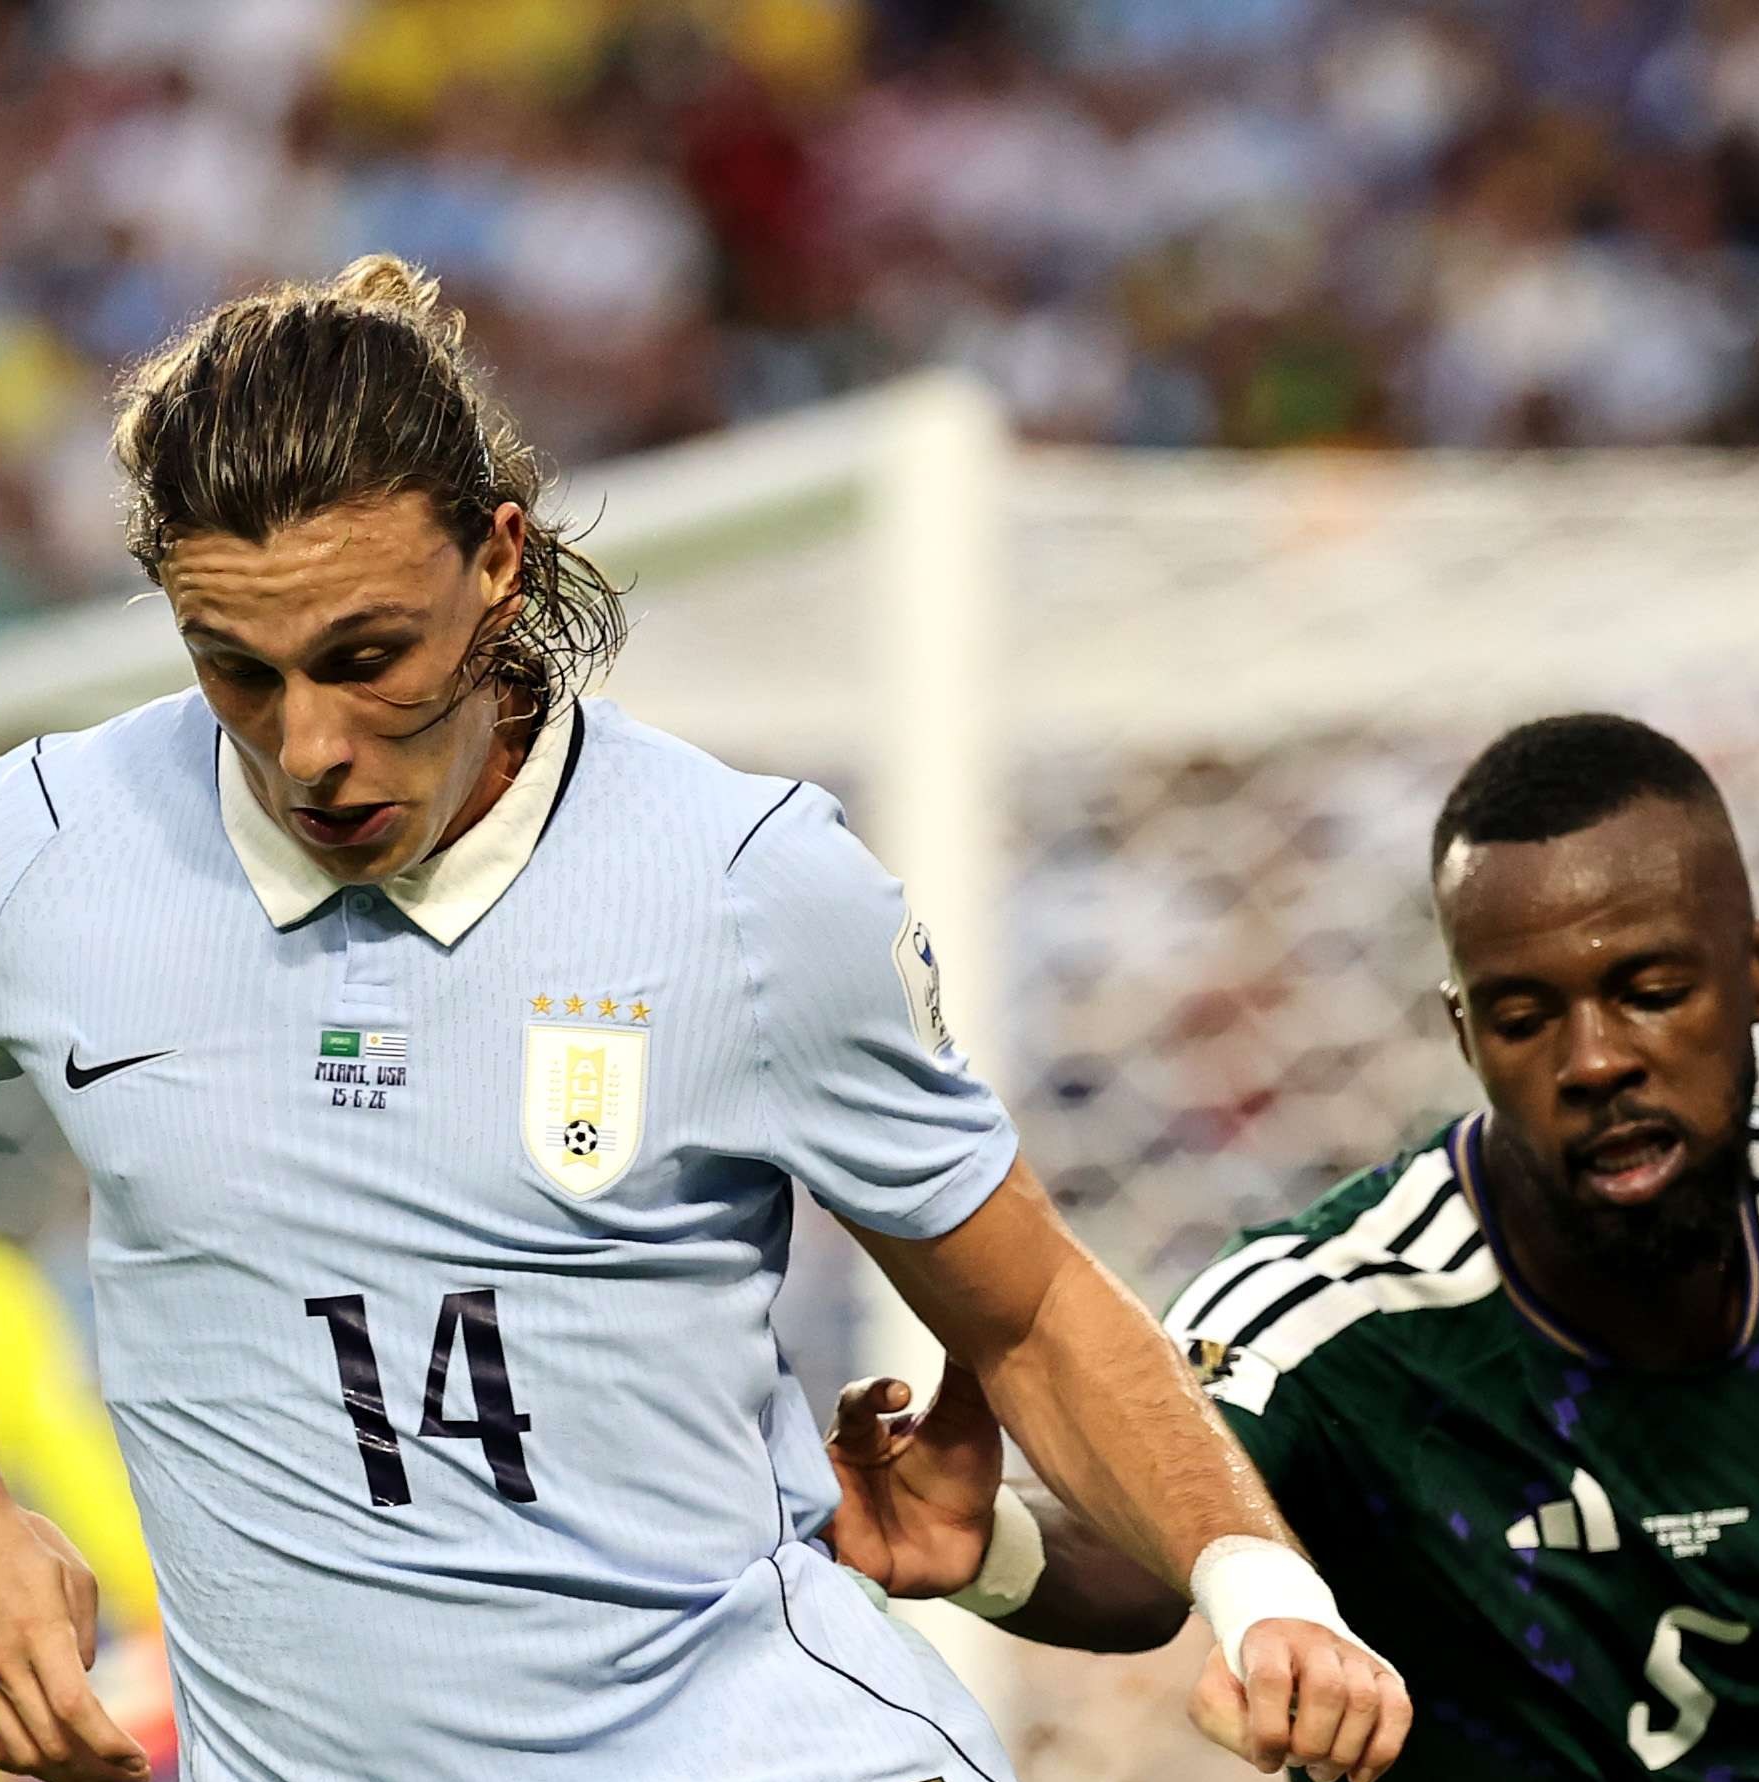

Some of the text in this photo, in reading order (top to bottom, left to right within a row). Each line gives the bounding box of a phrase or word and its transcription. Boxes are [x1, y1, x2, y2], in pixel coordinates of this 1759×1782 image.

[314, 1061, 407, 1087] MIAMI, USA
[305, 1289, 538, 1507] 14
[1627, 1605, 1750, 1771] 5
